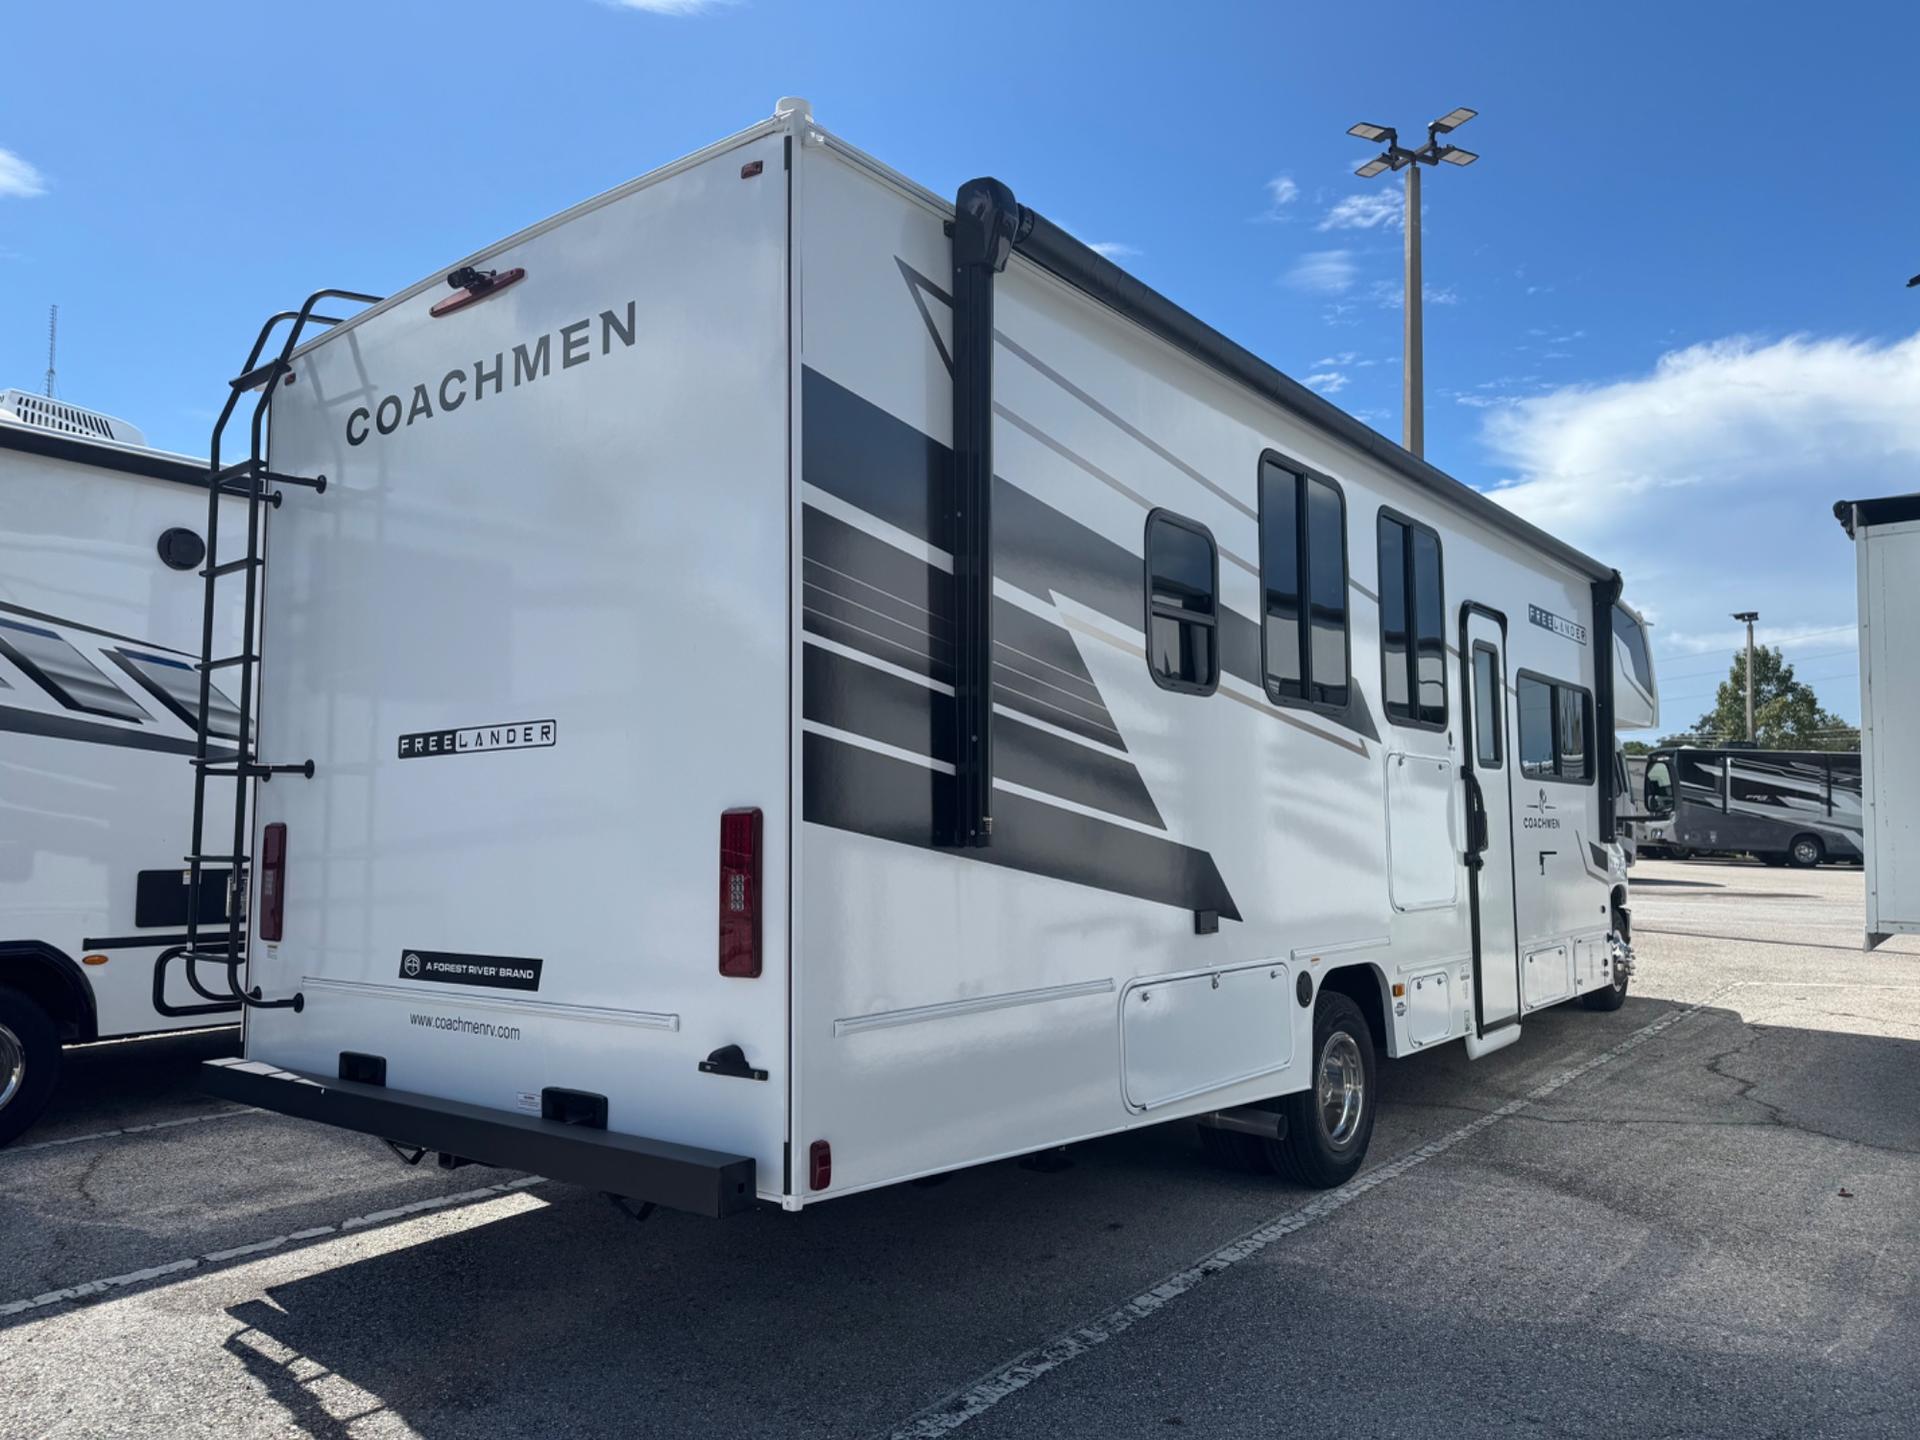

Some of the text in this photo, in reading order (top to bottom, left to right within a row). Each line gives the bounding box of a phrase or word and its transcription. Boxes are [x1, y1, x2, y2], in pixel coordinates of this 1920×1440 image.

[345, 301, 636, 446] COACHMEN
[400, 725, 551, 754] FREELANDER
[425, 961, 433, 971] A
[434, 962, 467, 974] FOREST
[499, 967, 534, 979] BRAND
[410, 1012, 520, 1041] www.coachmenrv.com
